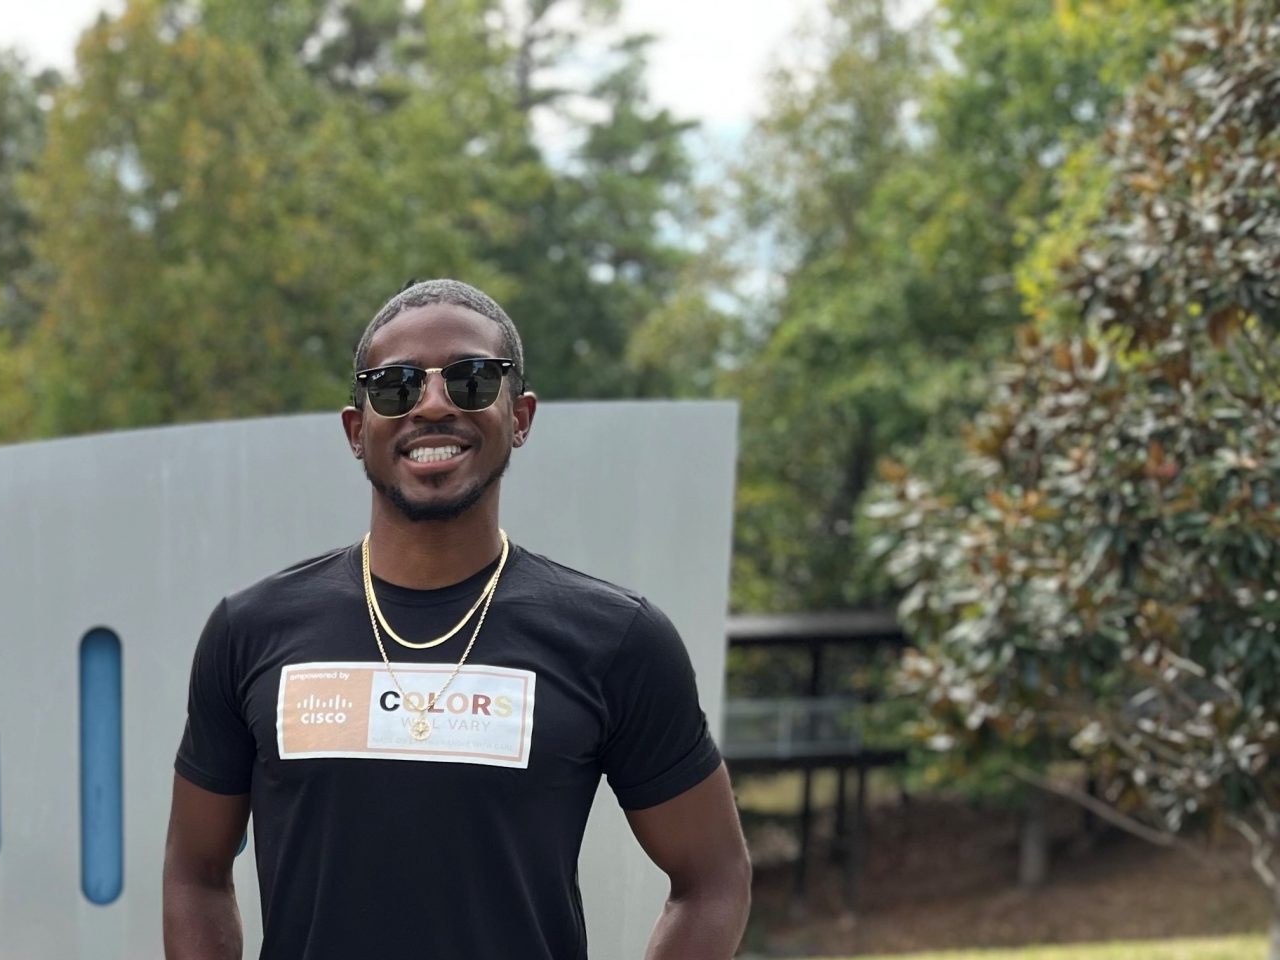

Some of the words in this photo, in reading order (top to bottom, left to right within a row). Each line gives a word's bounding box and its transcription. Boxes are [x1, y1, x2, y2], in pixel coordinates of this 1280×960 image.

[289, 671, 337, 681] empowered
[339, 671, 350, 681] by
[379, 690, 513, 717] COLORS
[300, 712, 346, 724] CISCO
[401, 717, 439, 731] WL
[448, 719, 491, 732] VARY
